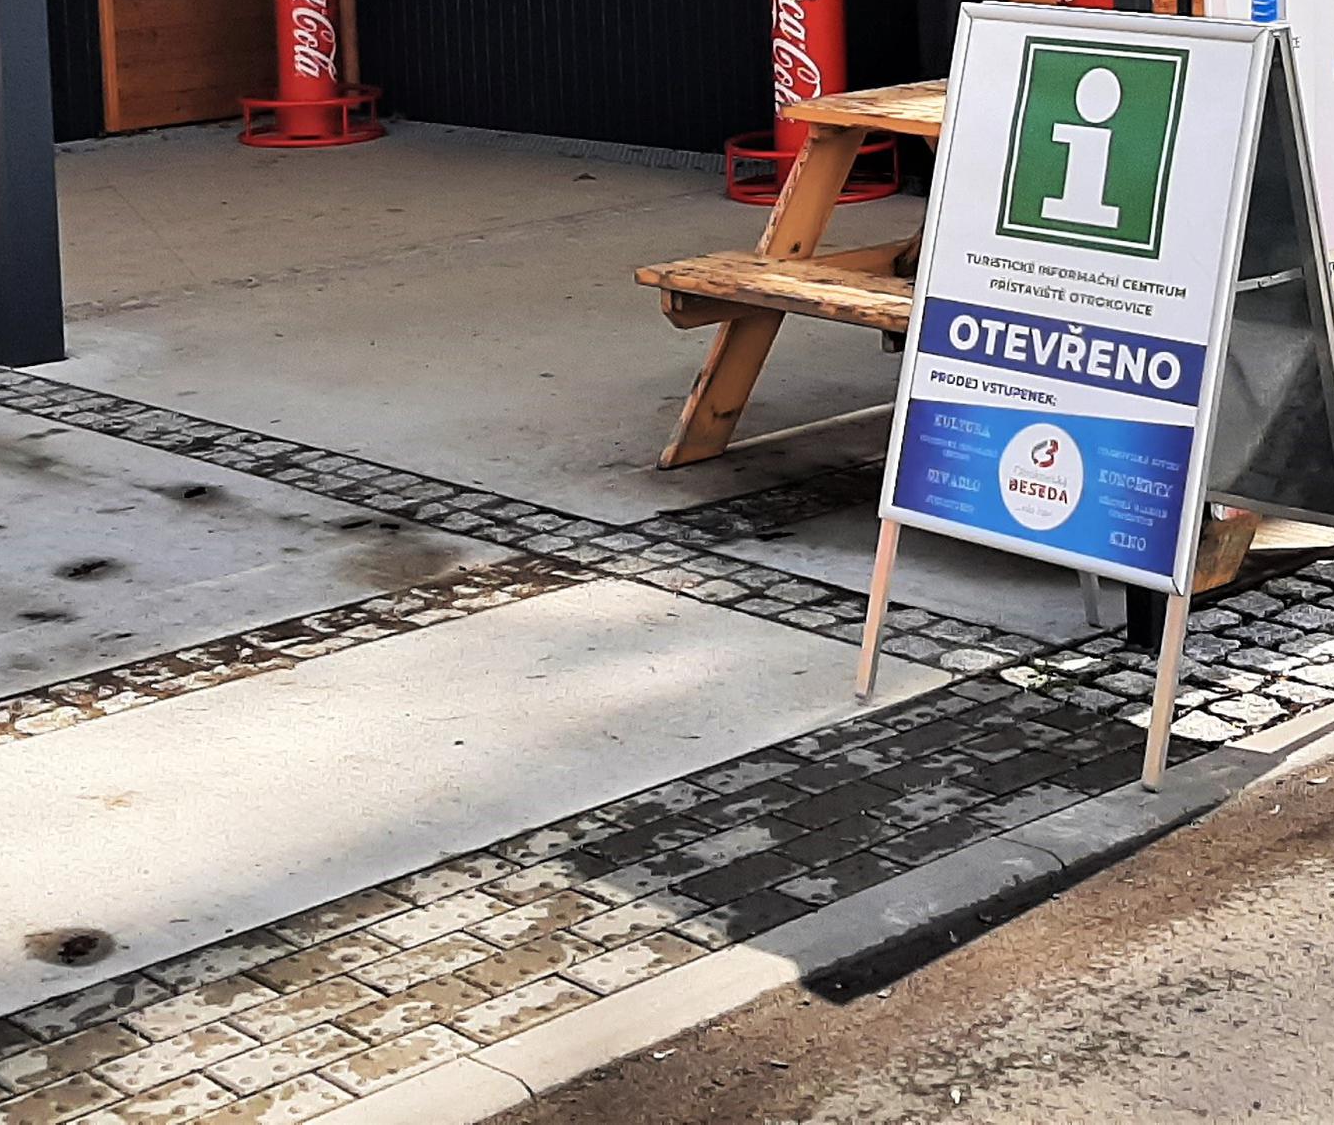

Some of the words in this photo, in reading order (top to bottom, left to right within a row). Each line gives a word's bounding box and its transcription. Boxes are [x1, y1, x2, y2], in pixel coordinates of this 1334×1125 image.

[967, 253, 1034, 275] TURISTICKÉ
[1039, 263, 1119, 287] INFORMAČNÍ
[1123, 278, 1186, 299] CENTRUM
[990, 277, 1065, 301] PŘÍSTAVIŠTĚ
[1069, 292, 1153, 317] OTROKOVICE
[949, 313, 1181, 390] OTEVŘENO
[930, 370, 978, 390] PRODEJ
[982, 381, 1058, 406] VSTUPENEK:
[1008, 477, 1068, 504] BESEDA
